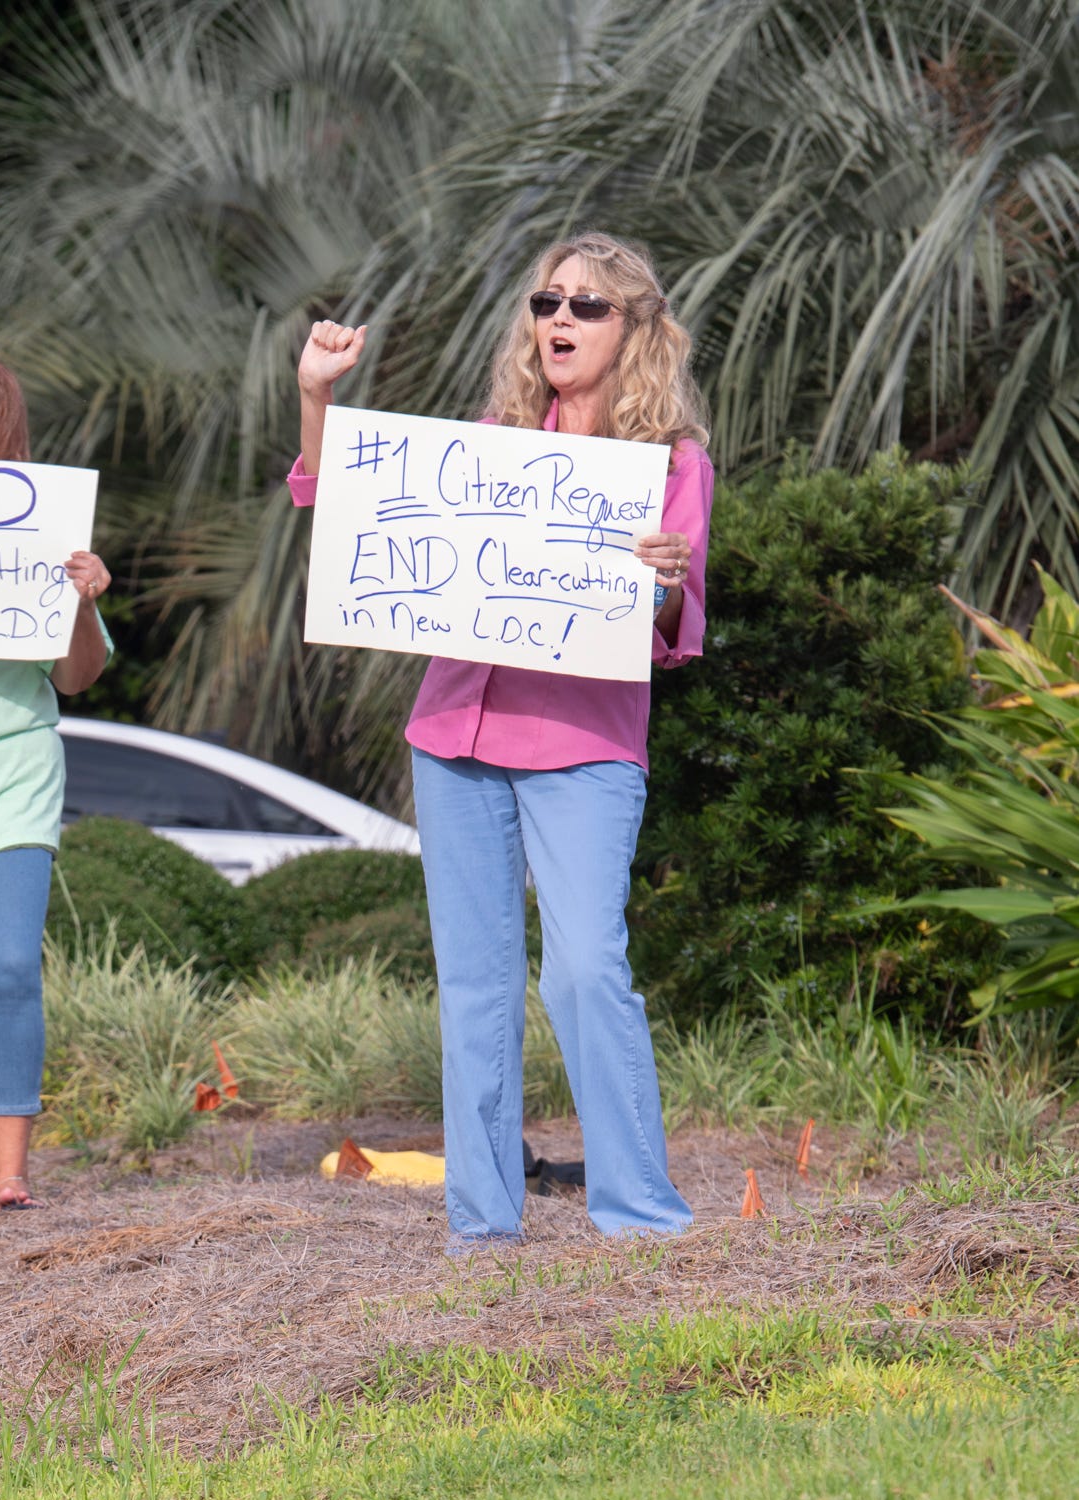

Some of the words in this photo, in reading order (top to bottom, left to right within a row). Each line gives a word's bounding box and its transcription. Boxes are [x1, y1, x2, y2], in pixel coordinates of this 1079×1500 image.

[345, 431, 418, 505] #1
[438, 439, 538, 509] Citizen
[523, 452, 656, 553] Request
[338, 603, 375, 628] in
[349, 531, 458, 593] END
[476, 537, 638, 621] Clear-cutting
